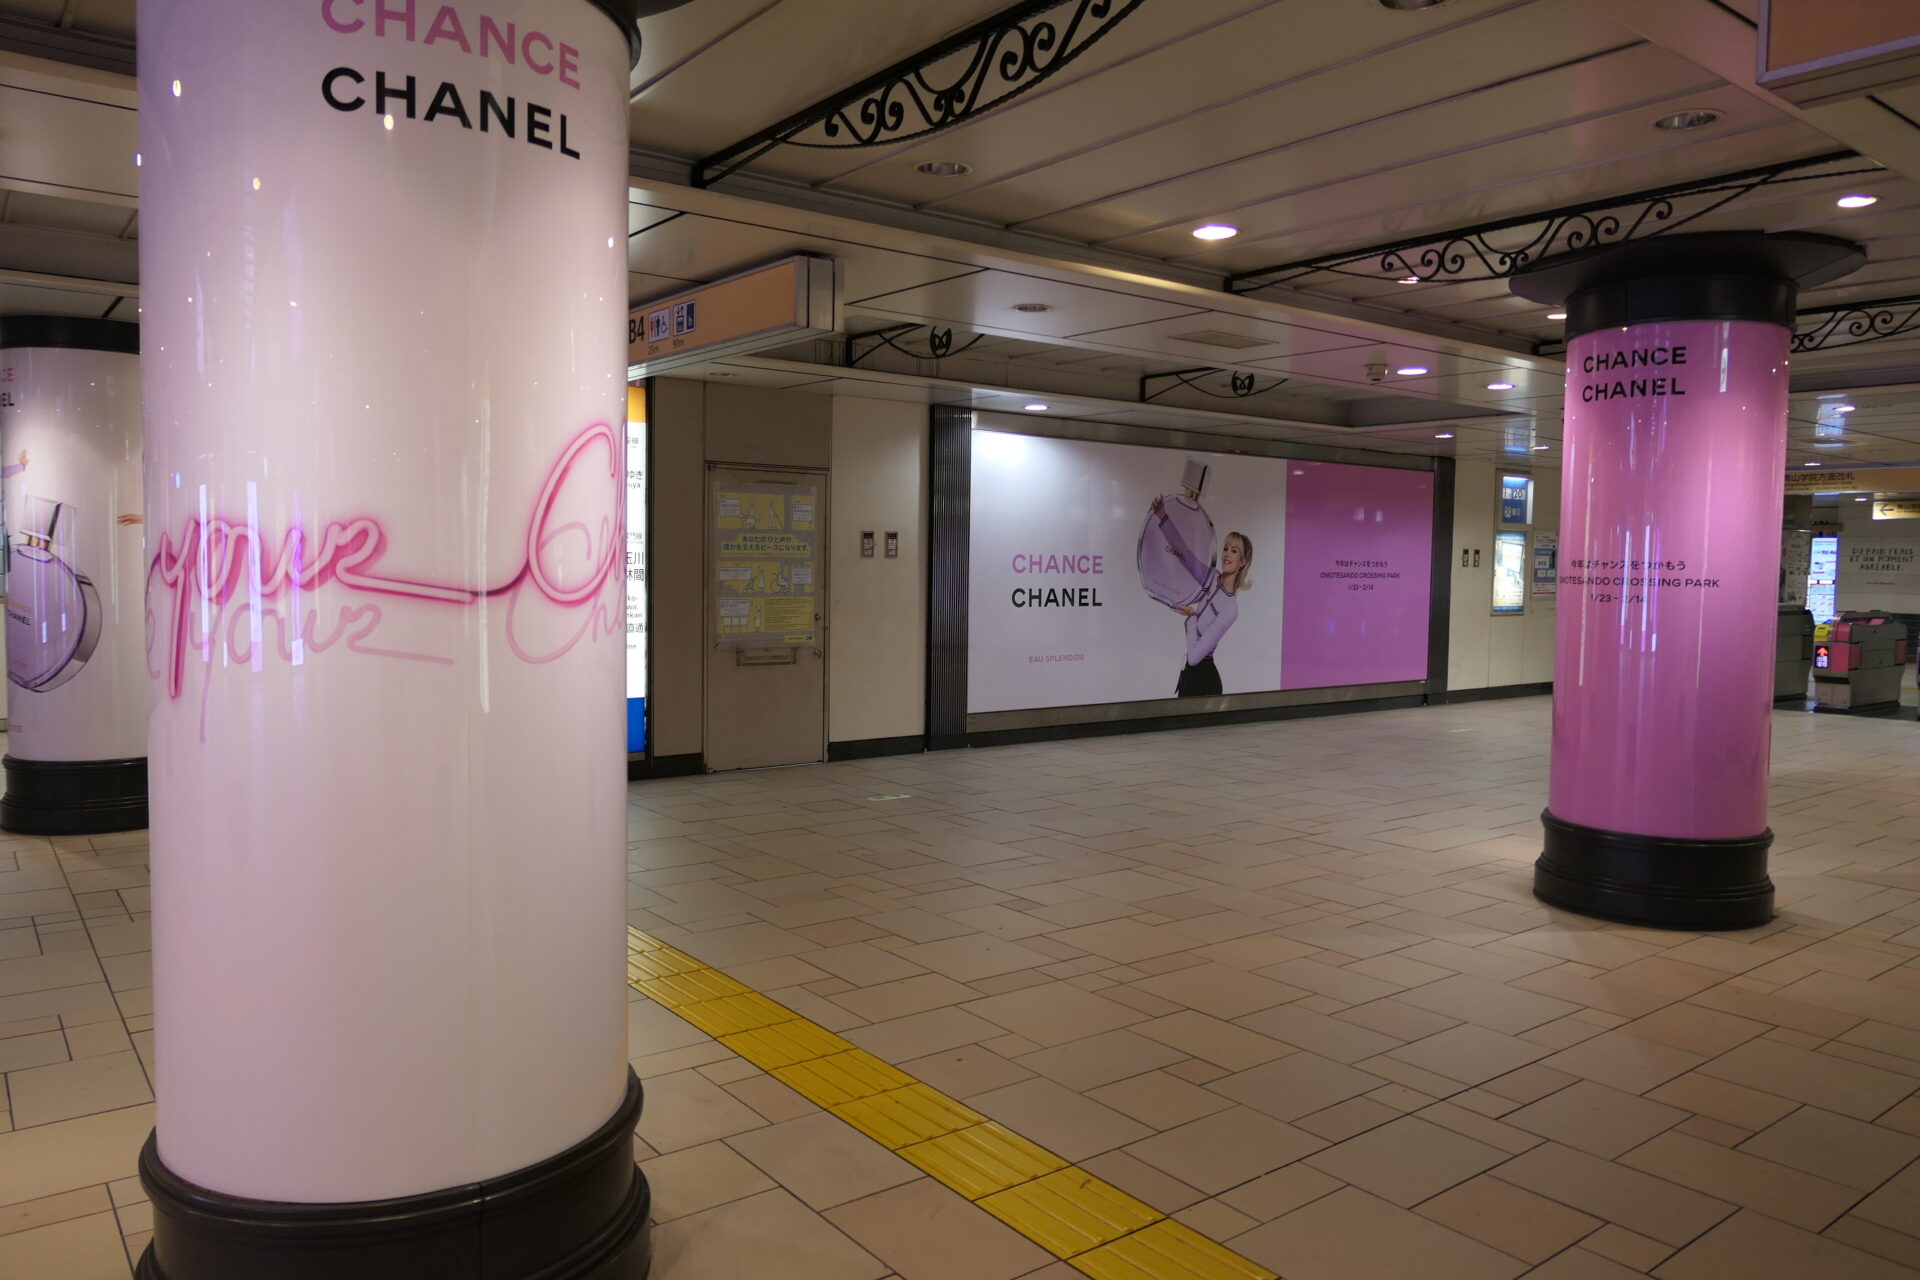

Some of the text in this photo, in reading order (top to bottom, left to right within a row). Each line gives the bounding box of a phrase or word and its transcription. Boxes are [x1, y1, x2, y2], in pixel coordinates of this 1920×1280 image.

[321, 0, 580, 90] CHANCE
[321, 67, 580, 160] CHANEL
[1583, 347, 1687, 373] CHANCE
[1582, 377, 1686, 403] CHANEL
[1012, 554, 1104, 574] CHANCE
[1685, 578, 1719, 588] PARK
[1011, 588, 1102, 608] CHANEL
[1045, 652, 1085, 663] SPLENDIDE
